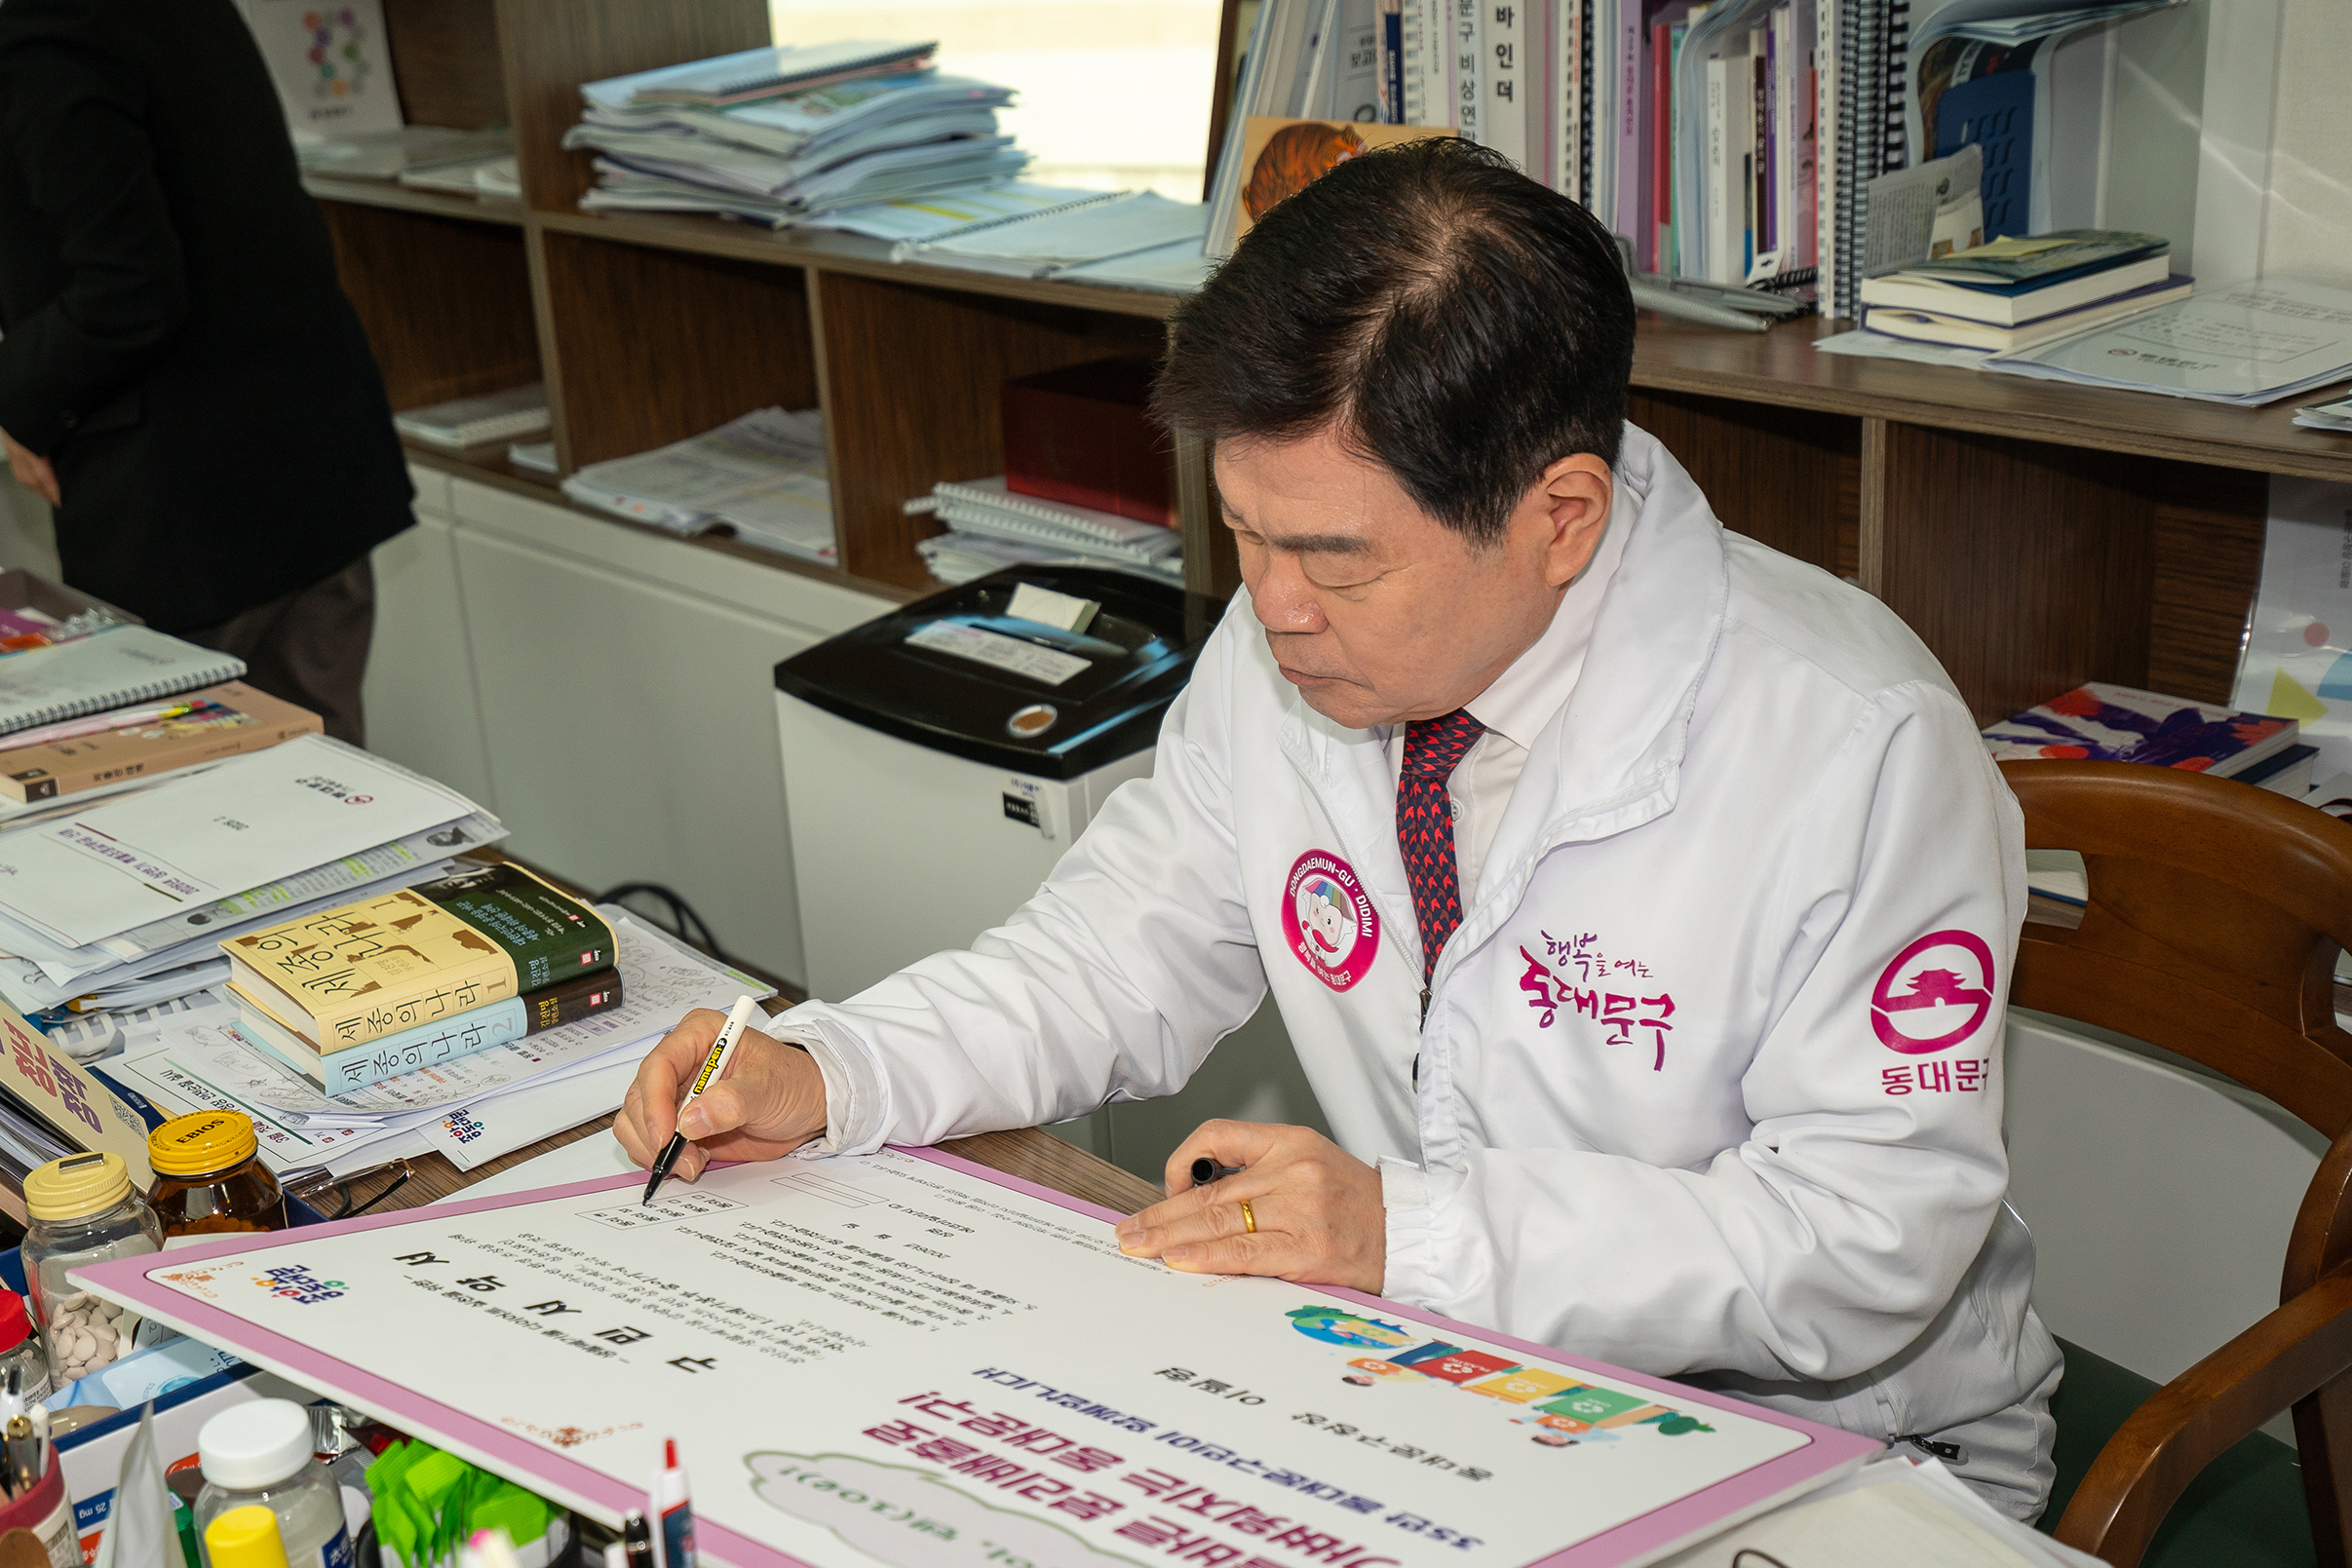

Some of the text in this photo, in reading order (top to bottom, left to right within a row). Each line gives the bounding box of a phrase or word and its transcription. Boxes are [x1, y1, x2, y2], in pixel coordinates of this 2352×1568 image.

[1496, 5, 1515, 102] 바인더
[1356, 895, 1373, 938] DIDIMI
[320, 913, 385, 964] 나라
[257, 927, 368, 1000] 세종의
[1540, 930, 1654, 983] 행복을 여는
[1519, 944, 1676, 1073] 동대문구
[175, 1118, 225, 1144] EBIOS
[267, 1132, 289, 1143] 3월
[656, 1208, 684, 1217] 동의
[680, 1204, 709, 1212] 동의
[606, 1217, 635, 1226] 동의
[770, 1219, 843, 1244] 챙기겠습니다.
[675, 1226, 738, 1247] 않겠습니다.
[740, 1222, 825, 1250] 사용하겠습니다.
[733, 1233, 819, 1262] 배출하겠습니다.
[735, 1247, 764, 1257] 넣지
[823, 1251, 852, 1261] 먼저
[843, 1245, 895, 1262] 텀블러를
[711, 1251, 797, 1282] 배출하겠습니다.
[762, 1256, 840, 1282] 종량제봉투에
[818, 1263, 849, 1272] 모아
[848, 1272, 875, 1281] 따로
[852, 1261, 915, 1282] 다회용기를
[894, 1262, 960, 1283] 장바구니와
[251, 1277, 323, 1305] 좋아요
[265, 1265, 350, 1299] 동대문
[798, 1282, 826, 1292] 따로
[874, 1281, 929, 1300] 깨끗하게
[829, 1292, 882, 1311] 쓰레기는
[839, 1282, 906, 1305] 플라스틱은
[916, 1282, 996, 1310] 일회용품보다
[977, 1290, 1017, 1304] 외출할
[881, 1312, 924, 1325] 음식물
[906, 1306, 948, 1320] 비닐과
[933, 1301, 974, 1315] 종이는
[1446, 1358, 1491, 1373] PLASTIC
[898, 1392, 1125, 1472] 동대문구!
[1154, 1367, 1492, 1481] 동대문구청장 이필형
[972, 1368, 1483, 1549] 35만 동대문구민이 함께합니다!
[862, 1420, 1126, 1520] 분리배출로
